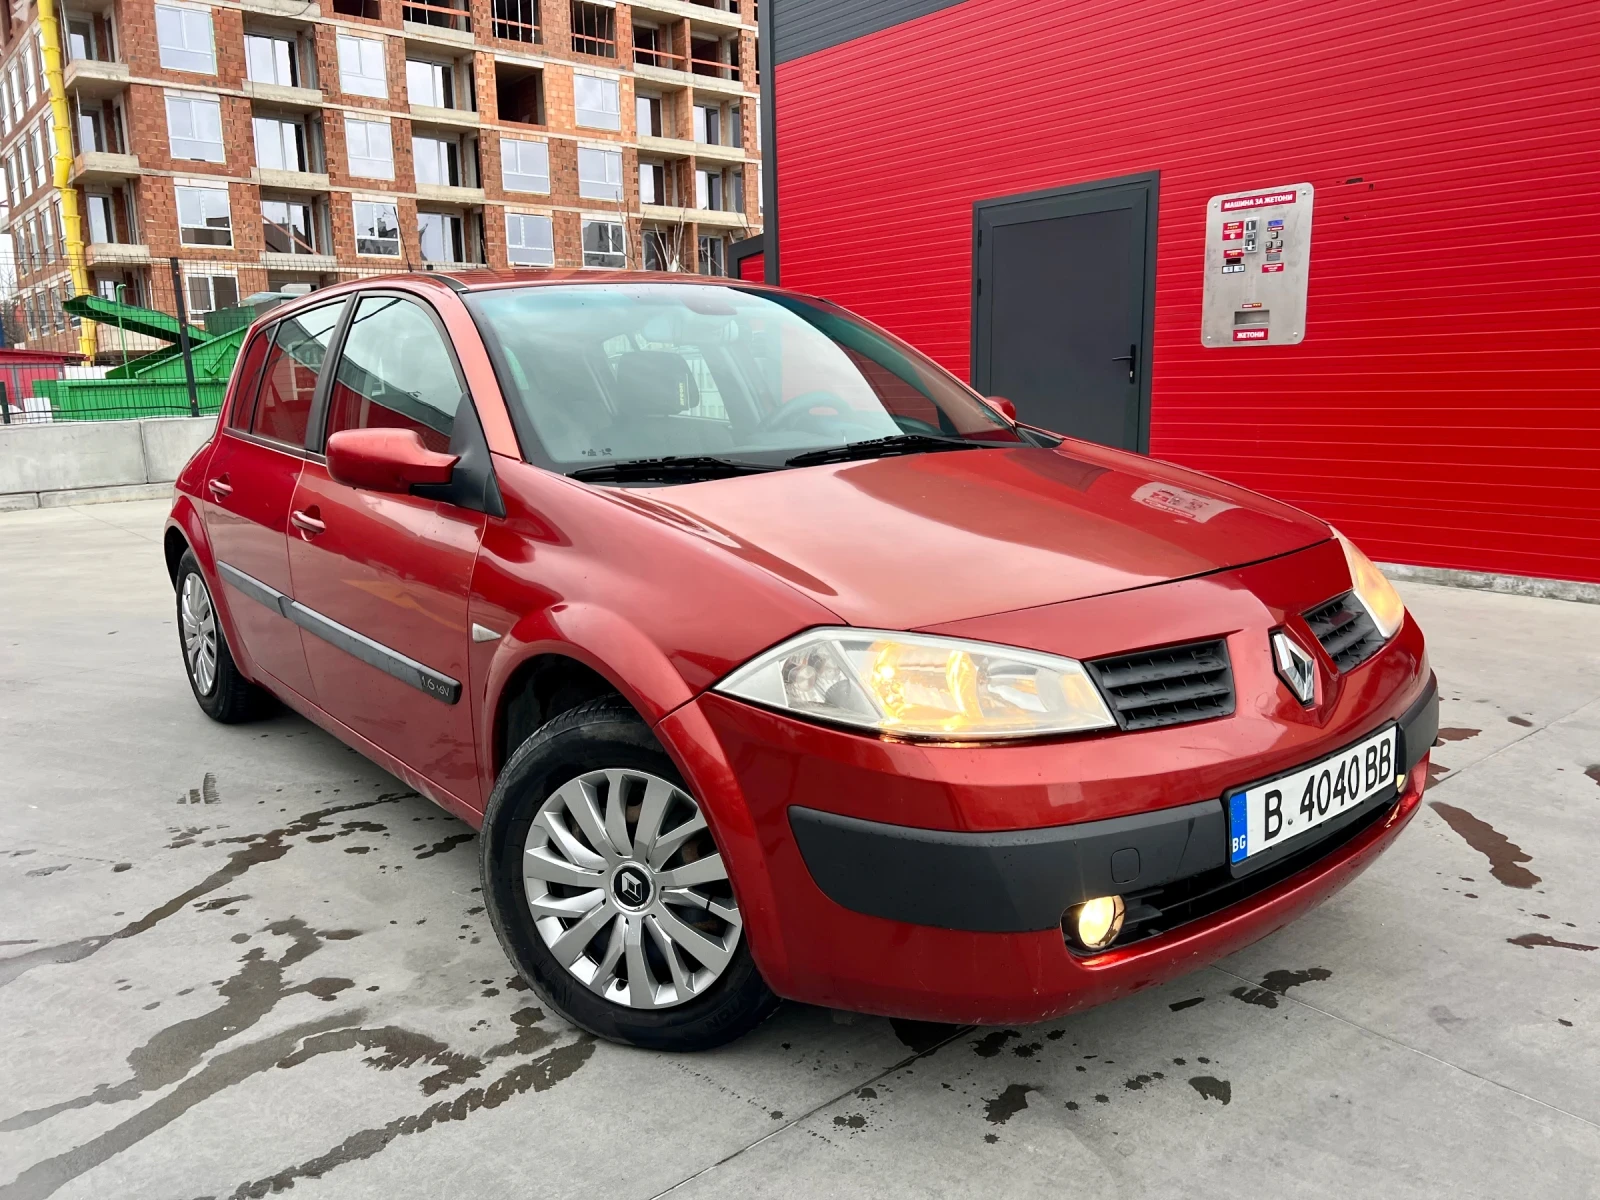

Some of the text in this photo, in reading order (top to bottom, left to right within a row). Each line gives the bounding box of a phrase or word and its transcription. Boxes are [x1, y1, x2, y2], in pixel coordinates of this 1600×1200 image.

[1224, 194, 1293, 209] МАШИНА ЗА ЖЕТОНИ
[1236, 331, 1265, 339] ЖЕТОНИ
[1265, 738, 1391, 842] B 4040 BB
[1232, 835, 1246, 853] BG
